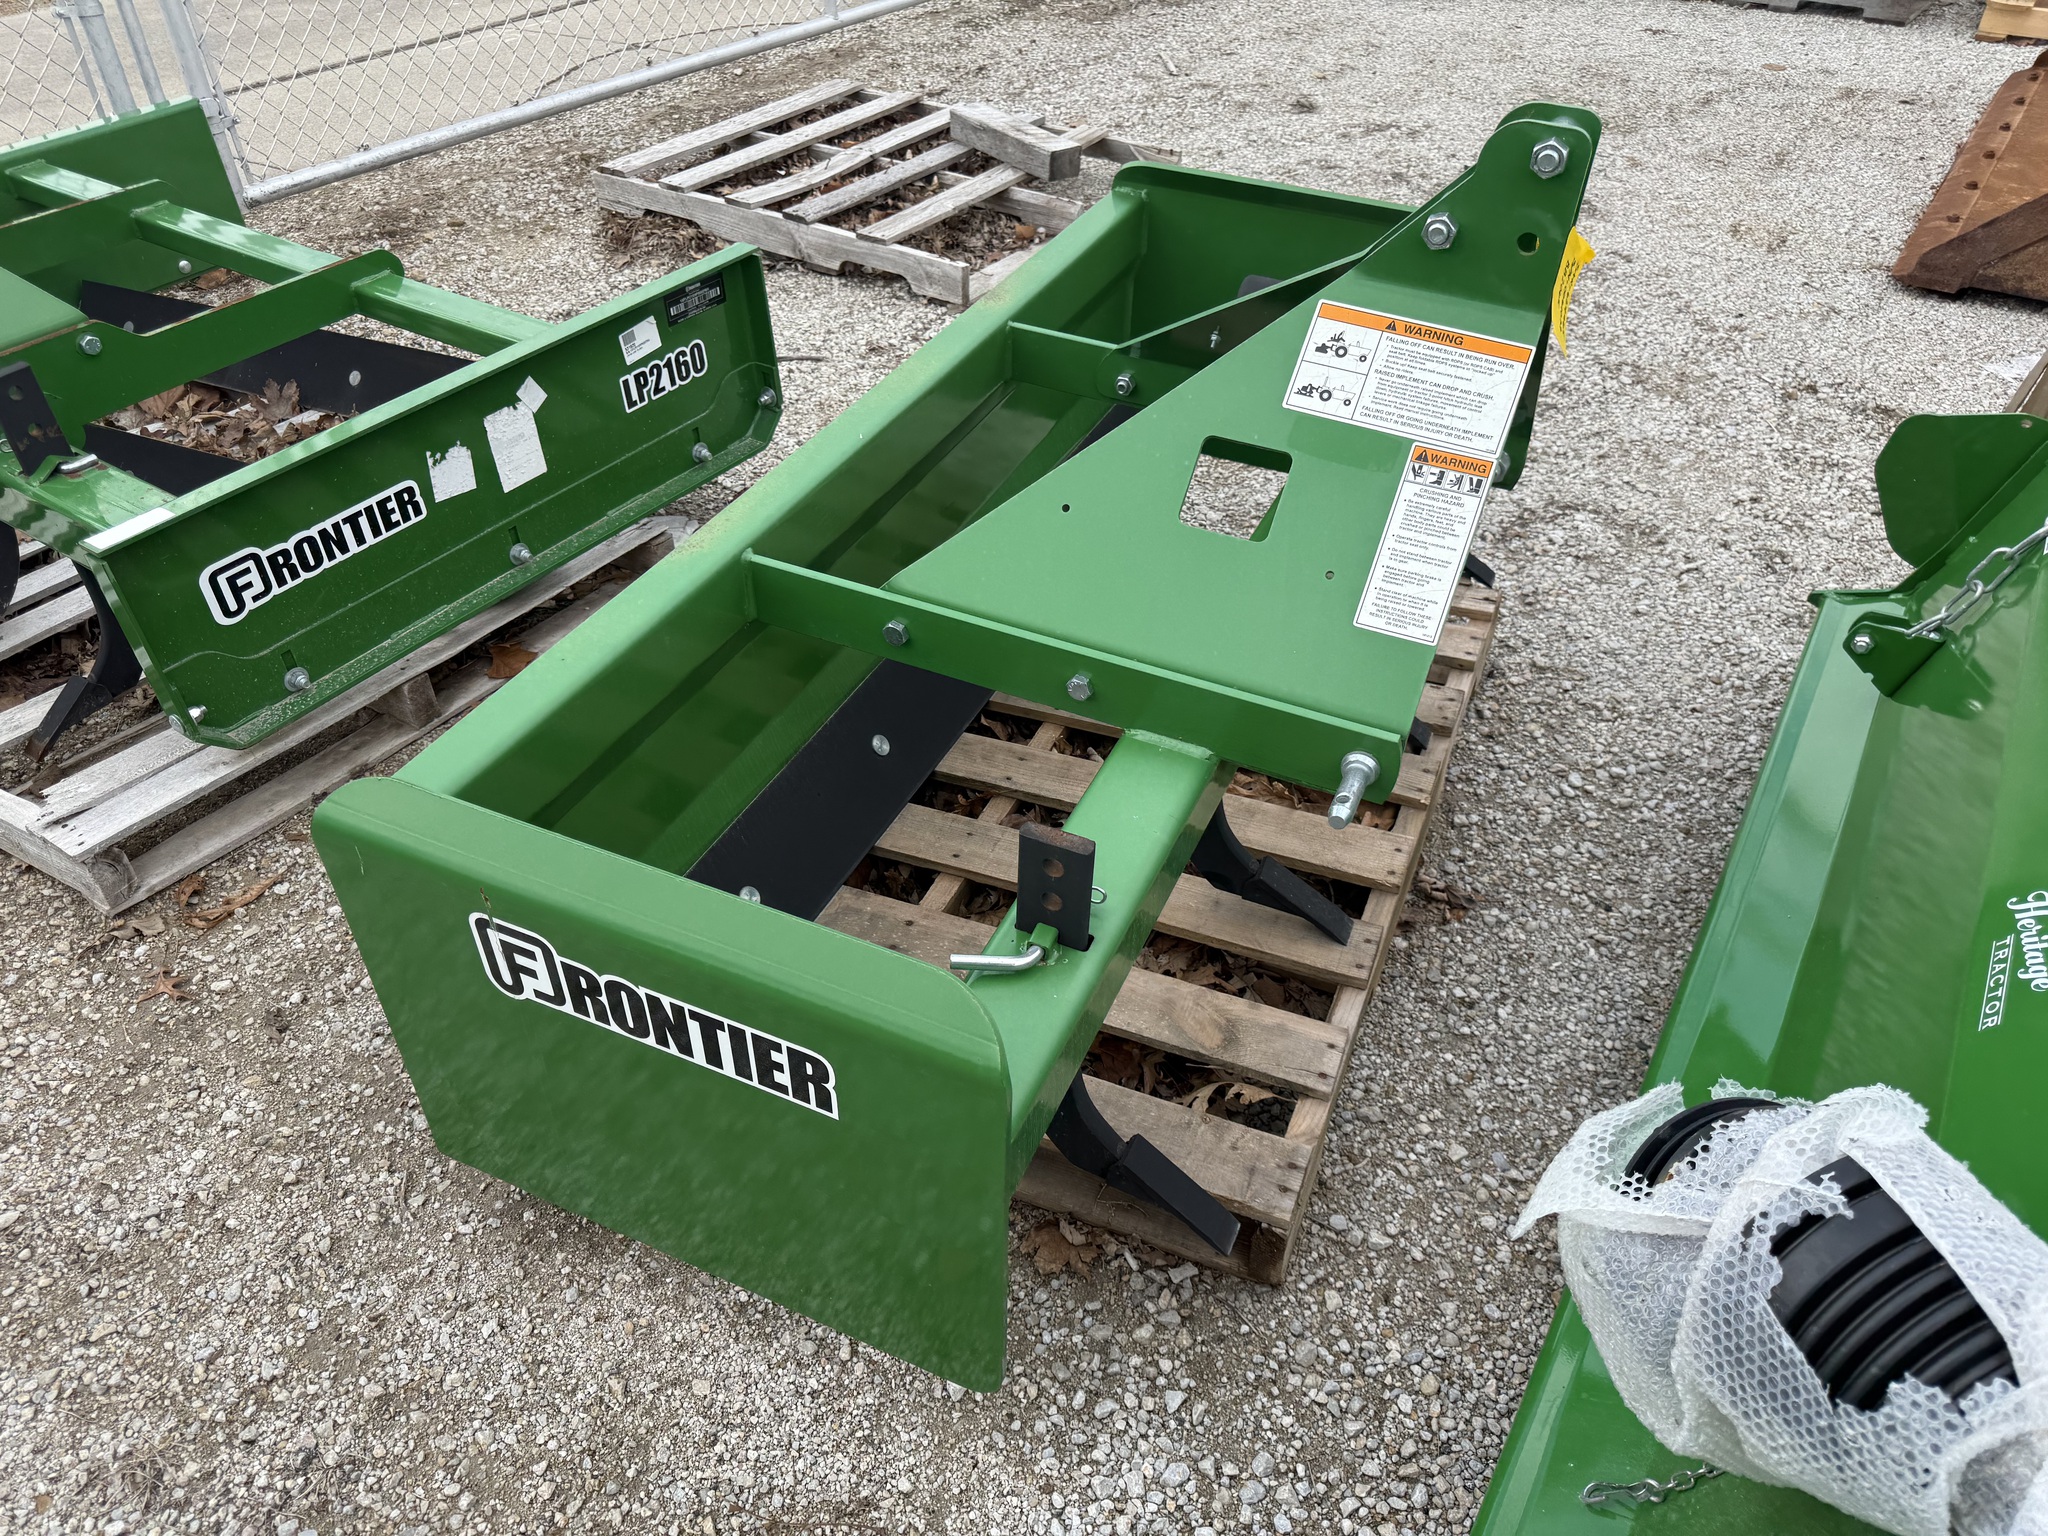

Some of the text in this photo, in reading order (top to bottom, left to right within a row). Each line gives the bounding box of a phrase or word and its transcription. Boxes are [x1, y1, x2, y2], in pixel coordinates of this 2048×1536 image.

[1402, 324, 1464, 345] WARNING
[1385, 335, 1409, 345] FALLING
[1434, 347, 1457, 356] RESULT
[1464, 353, 1483, 362] BEING
[622, 343, 705, 409] LP2160
[1373, 368, 1395, 377] RAISED
[1395, 373, 1428, 385] IMPLEMENT
[1441, 384, 1459, 392] DROP
[1361, 405, 1384, 414] FALLING
[1405, 415, 1423, 424] GOING
[1423, 419, 1461, 432] UNDERNEATH
[1461, 428, 1493, 440] IMPLEMENT
[1371, 414, 1392, 423] RESULT
[1399, 420, 1424, 430] SERIOUS
[1423, 426, 1444, 435] INJURY
[1429, 453, 1487, 473] WARNING
[1412, 492, 1464, 508] PINCHING HAZARD
[1419, 487, 1449, 498] CRUSHING
[209, 485, 423, 619] FRONTIER
[1368, 611, 1385, 619] RESULT
[1391, 617, 1411, 625] SERIOUS
[1375, 608, 1407, 619] INSTRUCTIONS
[1397, 608, 1416, 616] FOLLOW
[1982, 935, 2010, 1030] TRACTOR
[475, 917, 833, 1114] FRONTIER
